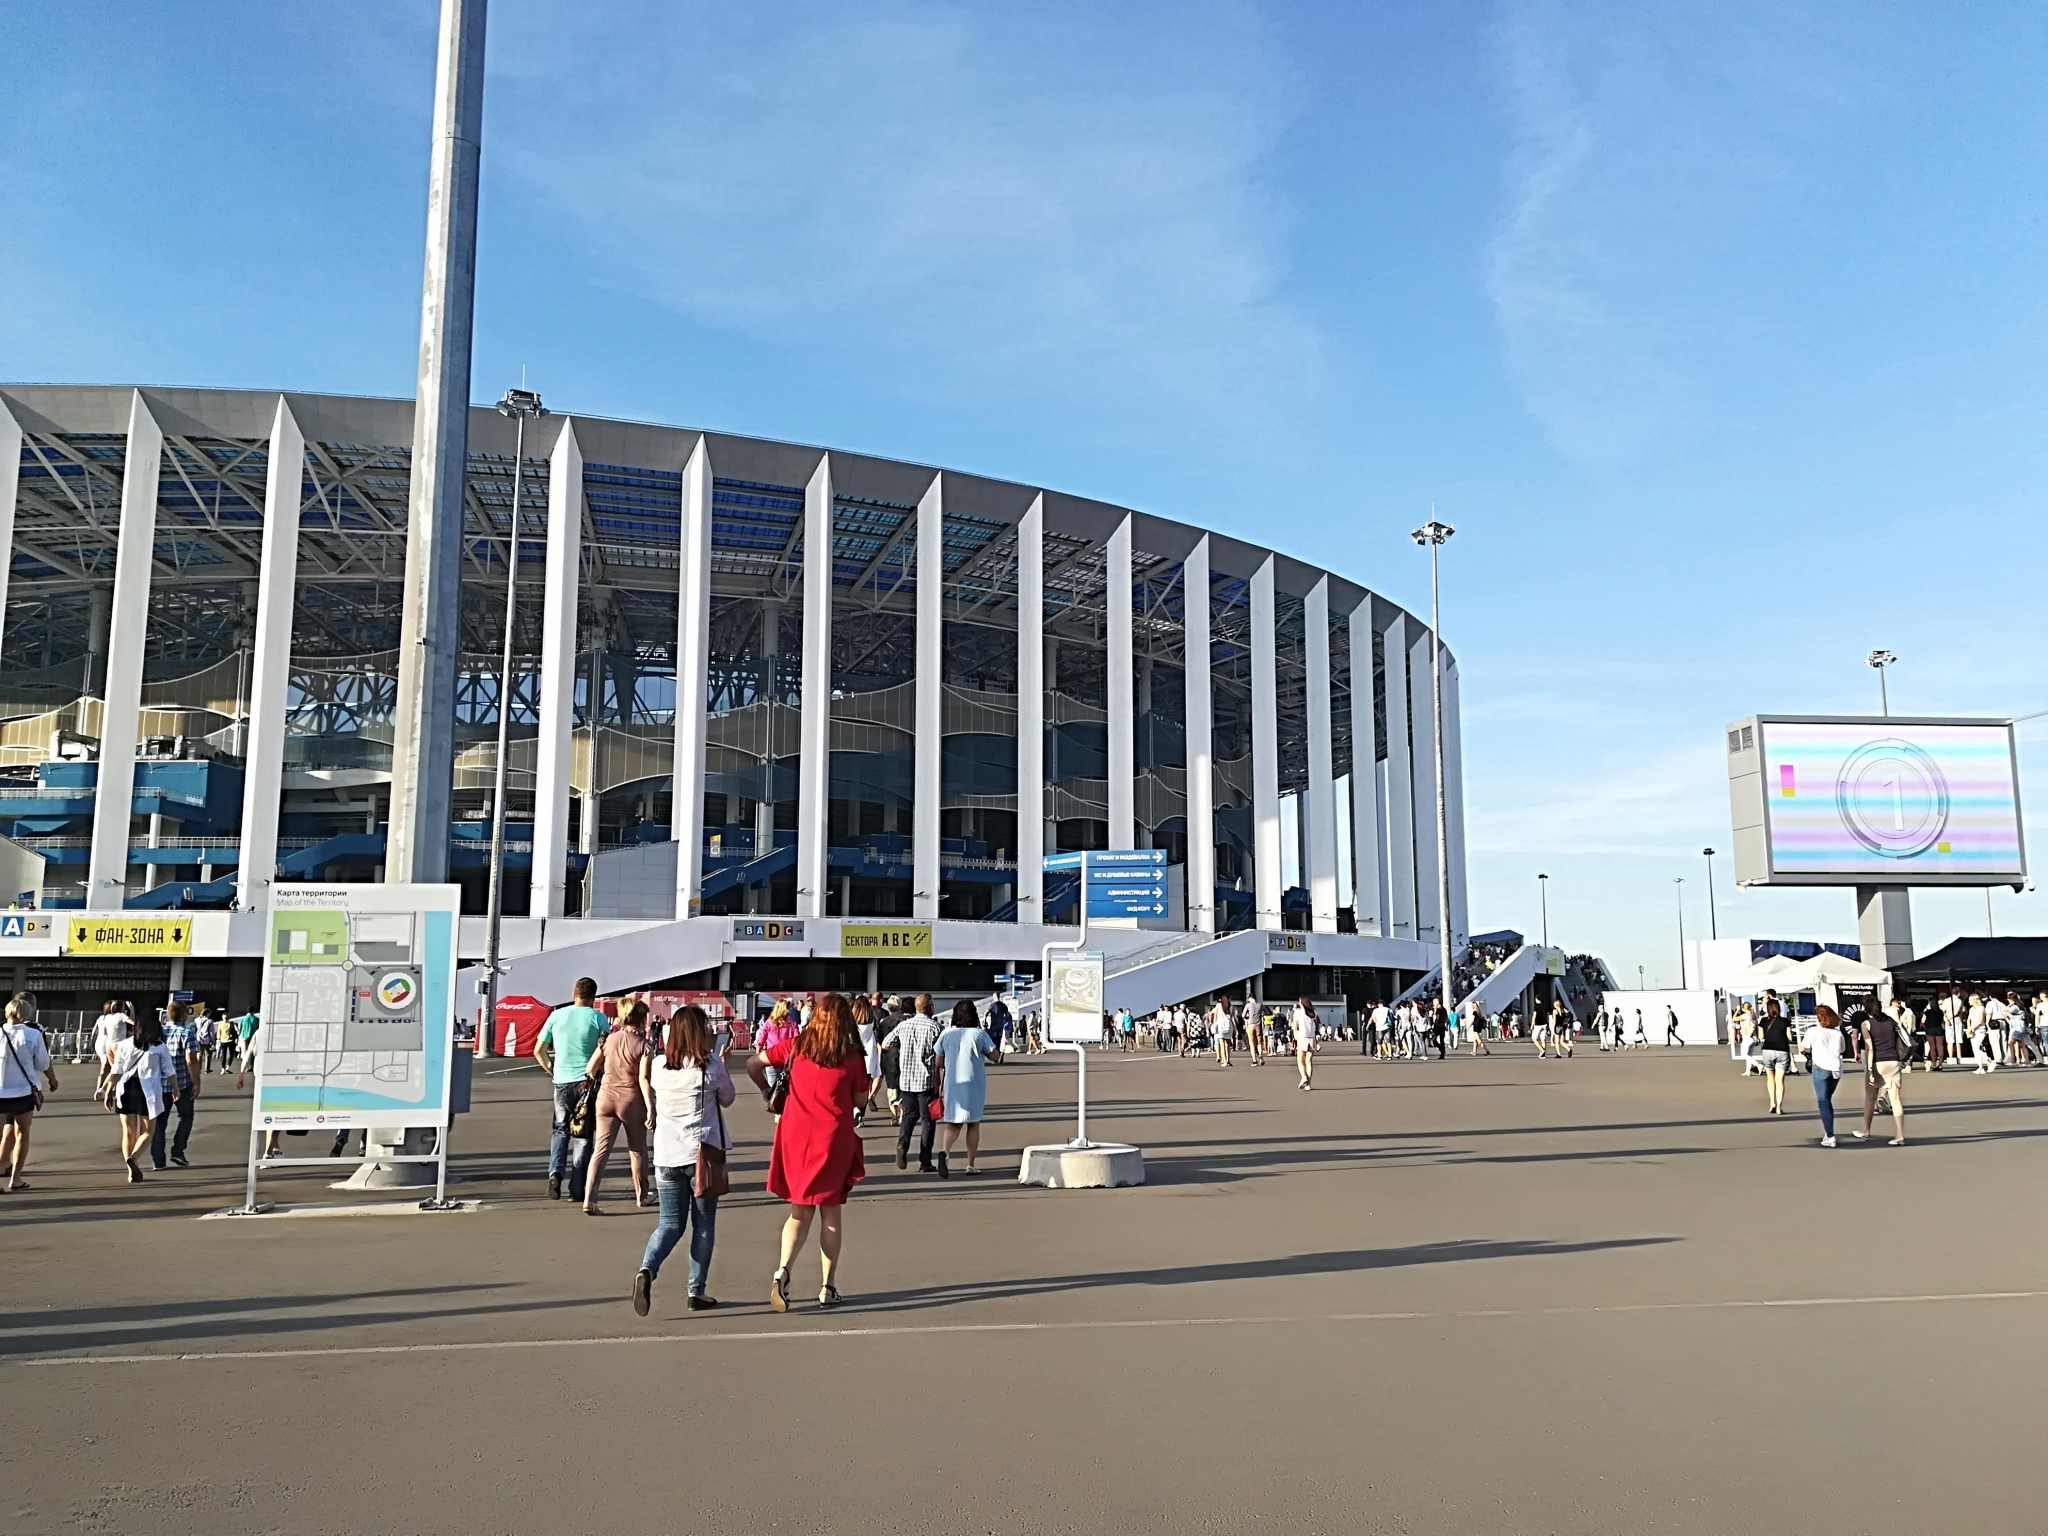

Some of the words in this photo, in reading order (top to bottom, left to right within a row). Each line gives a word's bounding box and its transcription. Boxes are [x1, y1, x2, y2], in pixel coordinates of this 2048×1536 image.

[277, 889, 300, 897] Карта
[302, 890, 347, 898] территории
[276, 899, 293, 907] Map
[318, 899, 349, 907] Territory
[3, 917, 24, 936] A
[27, 922, 35, 932] D
[768, 923, 780, 938] D
[95, 927, 164, 944] ФАН-ЗОНА
[845, 936, 878, 947] СЕКТОРА
[1287, 936, 1294, 950] D
